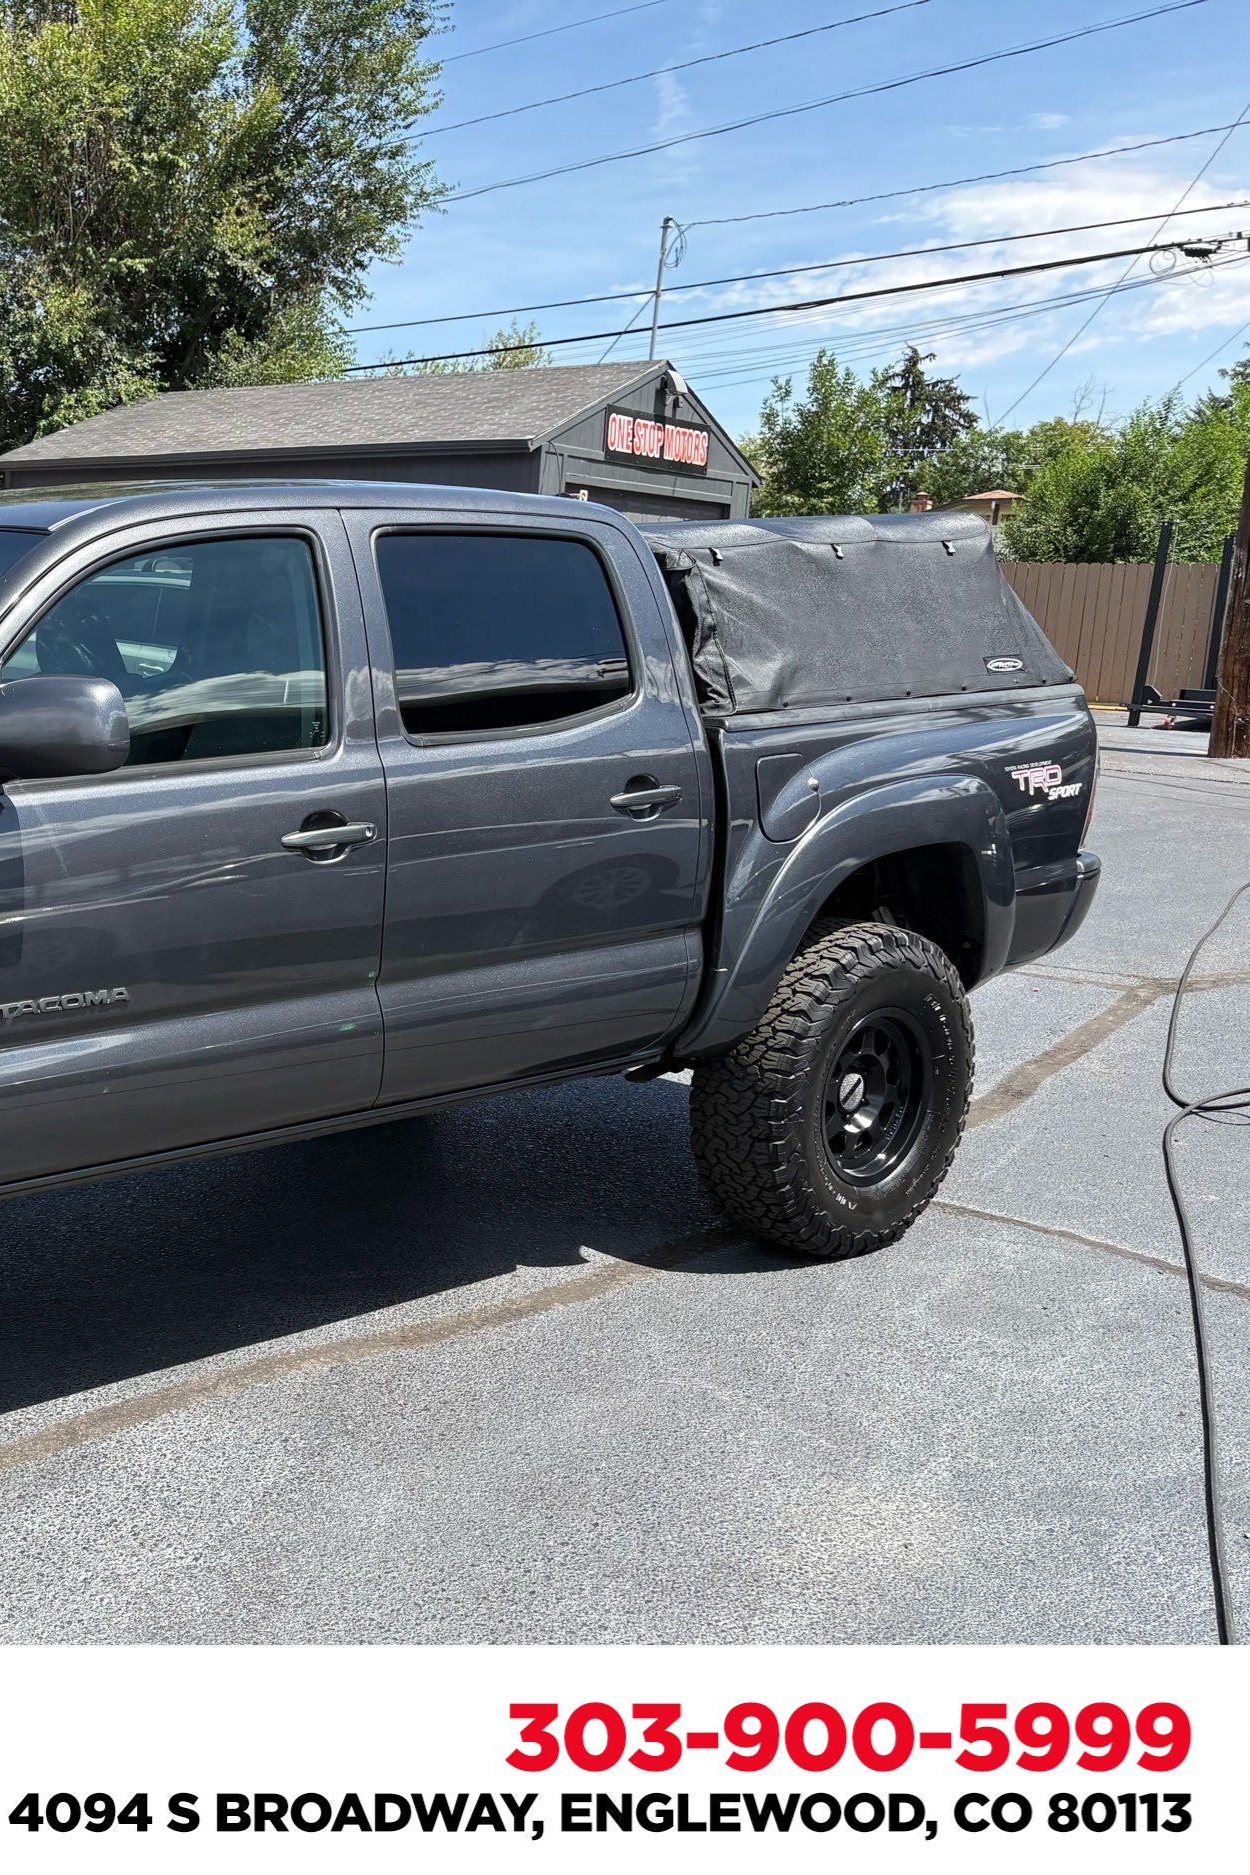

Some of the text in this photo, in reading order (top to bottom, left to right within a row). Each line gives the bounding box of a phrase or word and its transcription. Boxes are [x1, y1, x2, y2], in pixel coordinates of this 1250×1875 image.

[608, 413, 708, 466] ONE STOP MOTORS
[1011, 764, 1062, 796] TRD
[1047, 782, 1083, 800] SPORT
